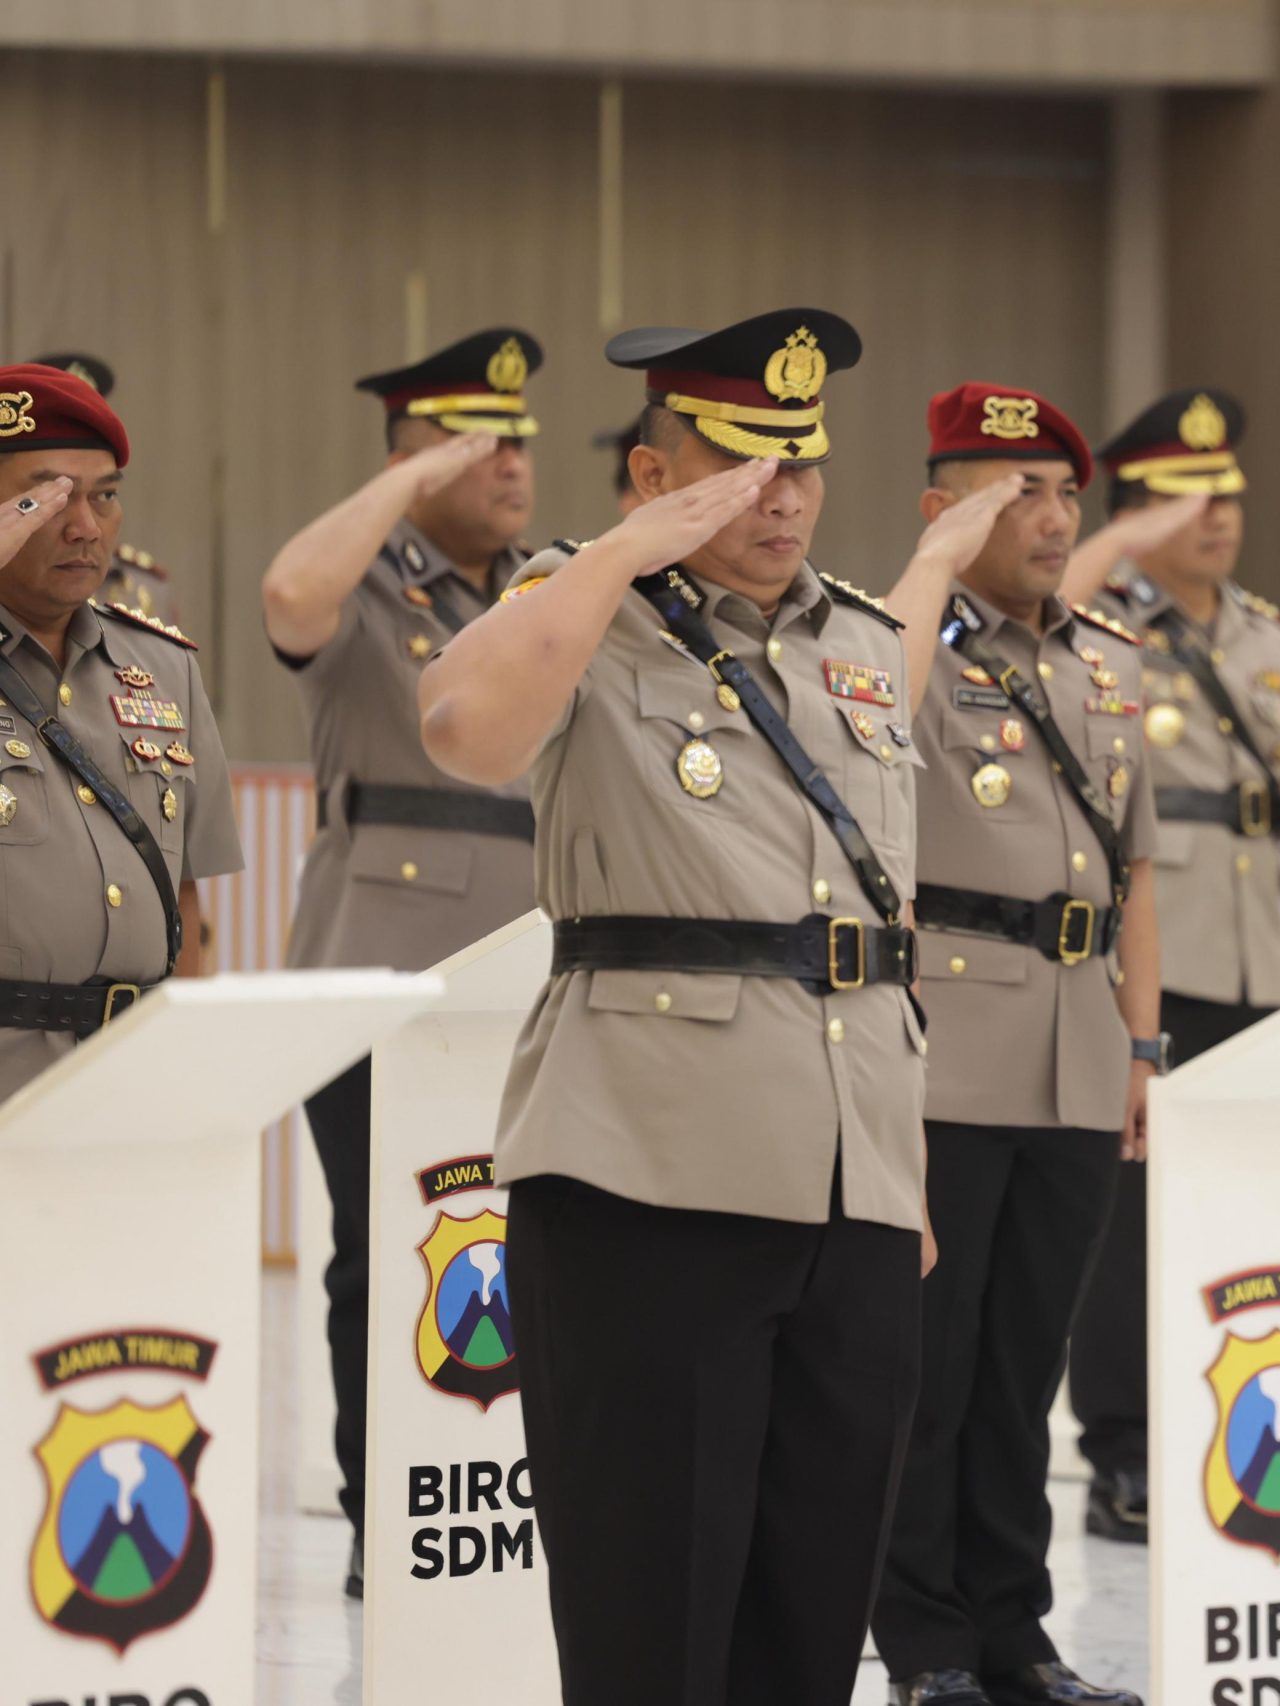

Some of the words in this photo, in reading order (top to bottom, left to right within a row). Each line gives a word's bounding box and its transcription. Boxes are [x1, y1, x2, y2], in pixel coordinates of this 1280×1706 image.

[434, 1164, 483, 1191] JAWA
[1222, 1275, 1277, 1310] JAWA
[55, 1338, 122, 1380] JAWA
[124, 1336, 199, 1370] TIMUR
[410, 1518, 534, 1580] SDM
